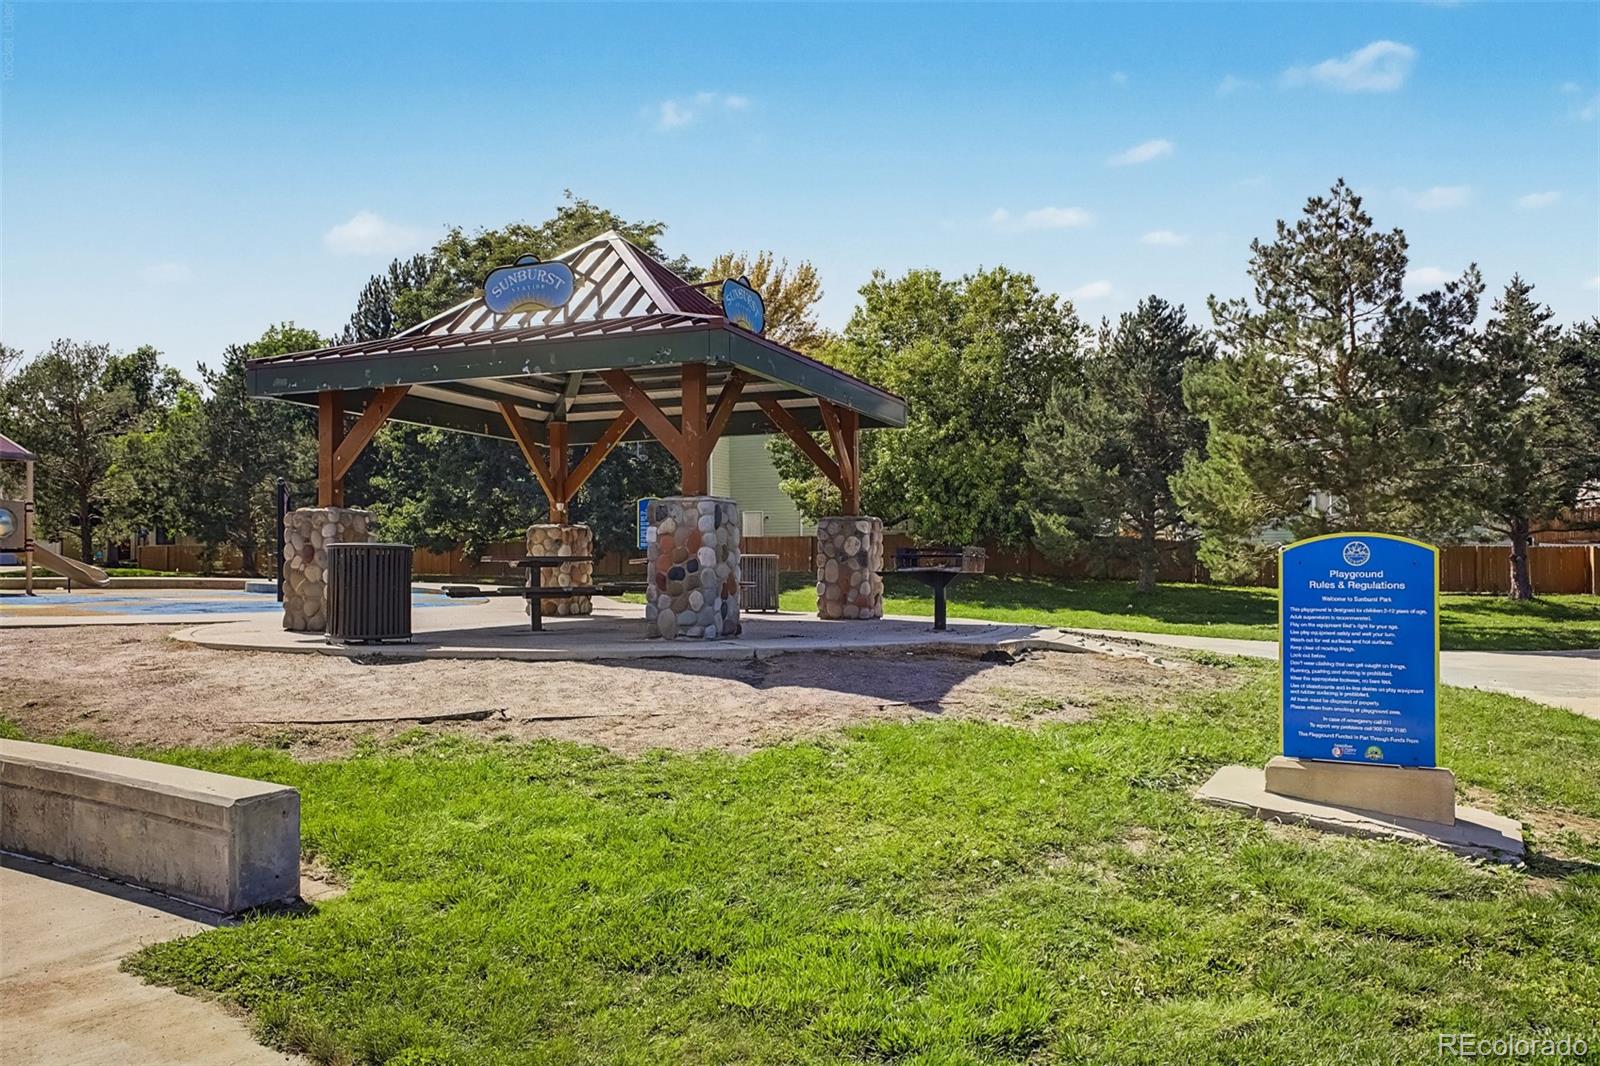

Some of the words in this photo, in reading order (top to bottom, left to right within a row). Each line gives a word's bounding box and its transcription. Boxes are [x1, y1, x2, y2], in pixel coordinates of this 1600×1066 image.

[491, 268, 566, 298] SUNBURST
[1329, 569, 1384, 580] Playground
[1309, 580, 1336, 589] Rules
[1348, 581, 1406, 591] Regulations
